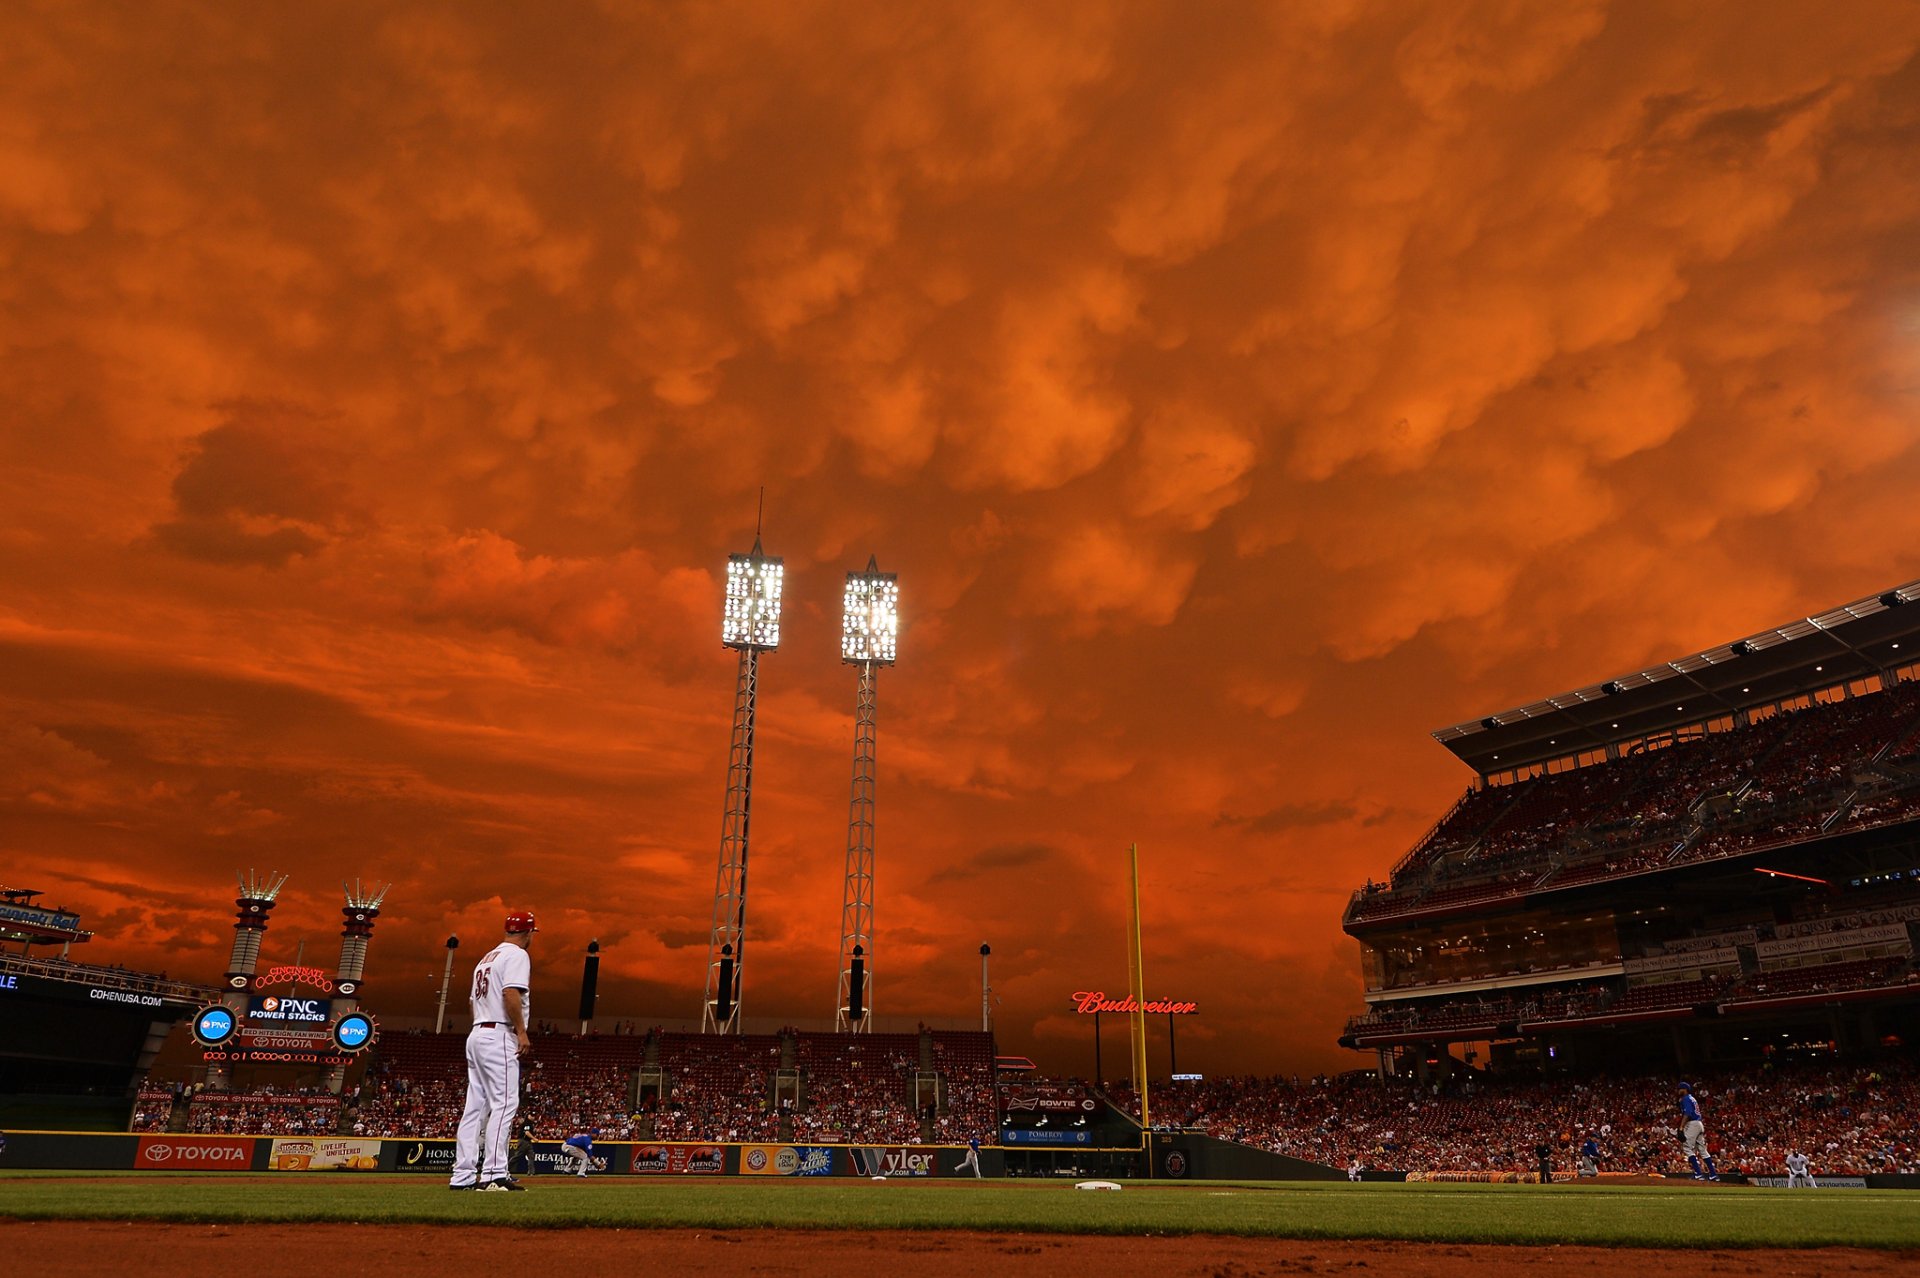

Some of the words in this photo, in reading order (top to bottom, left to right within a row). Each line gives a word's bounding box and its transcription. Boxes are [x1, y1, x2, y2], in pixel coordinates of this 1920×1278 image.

[1867, 927, 1900, 938] CASINO
[270, 966, 324, 978] CINCINNATI
[90, 989, 162, 1006] COHENUSA.COM
[280, 999, 318, 1014] PNC
[250, 1010, 285, 1020] POWER
[288, 1012, 325, 1021] STACKS
[211, 1021, 230, 1030] PNC
[350, 1028, 367, 1036] PNC
[271, 1038, 313, 1048] TOYOTA
[1039, 1099, 1076, 1107] BOWTIE
[175, 1146, 245, 1161] TOYOTA
[326, 1148, 361, 1157] UNFILTERED
[848, 1148, 934, 1176] Wyler
